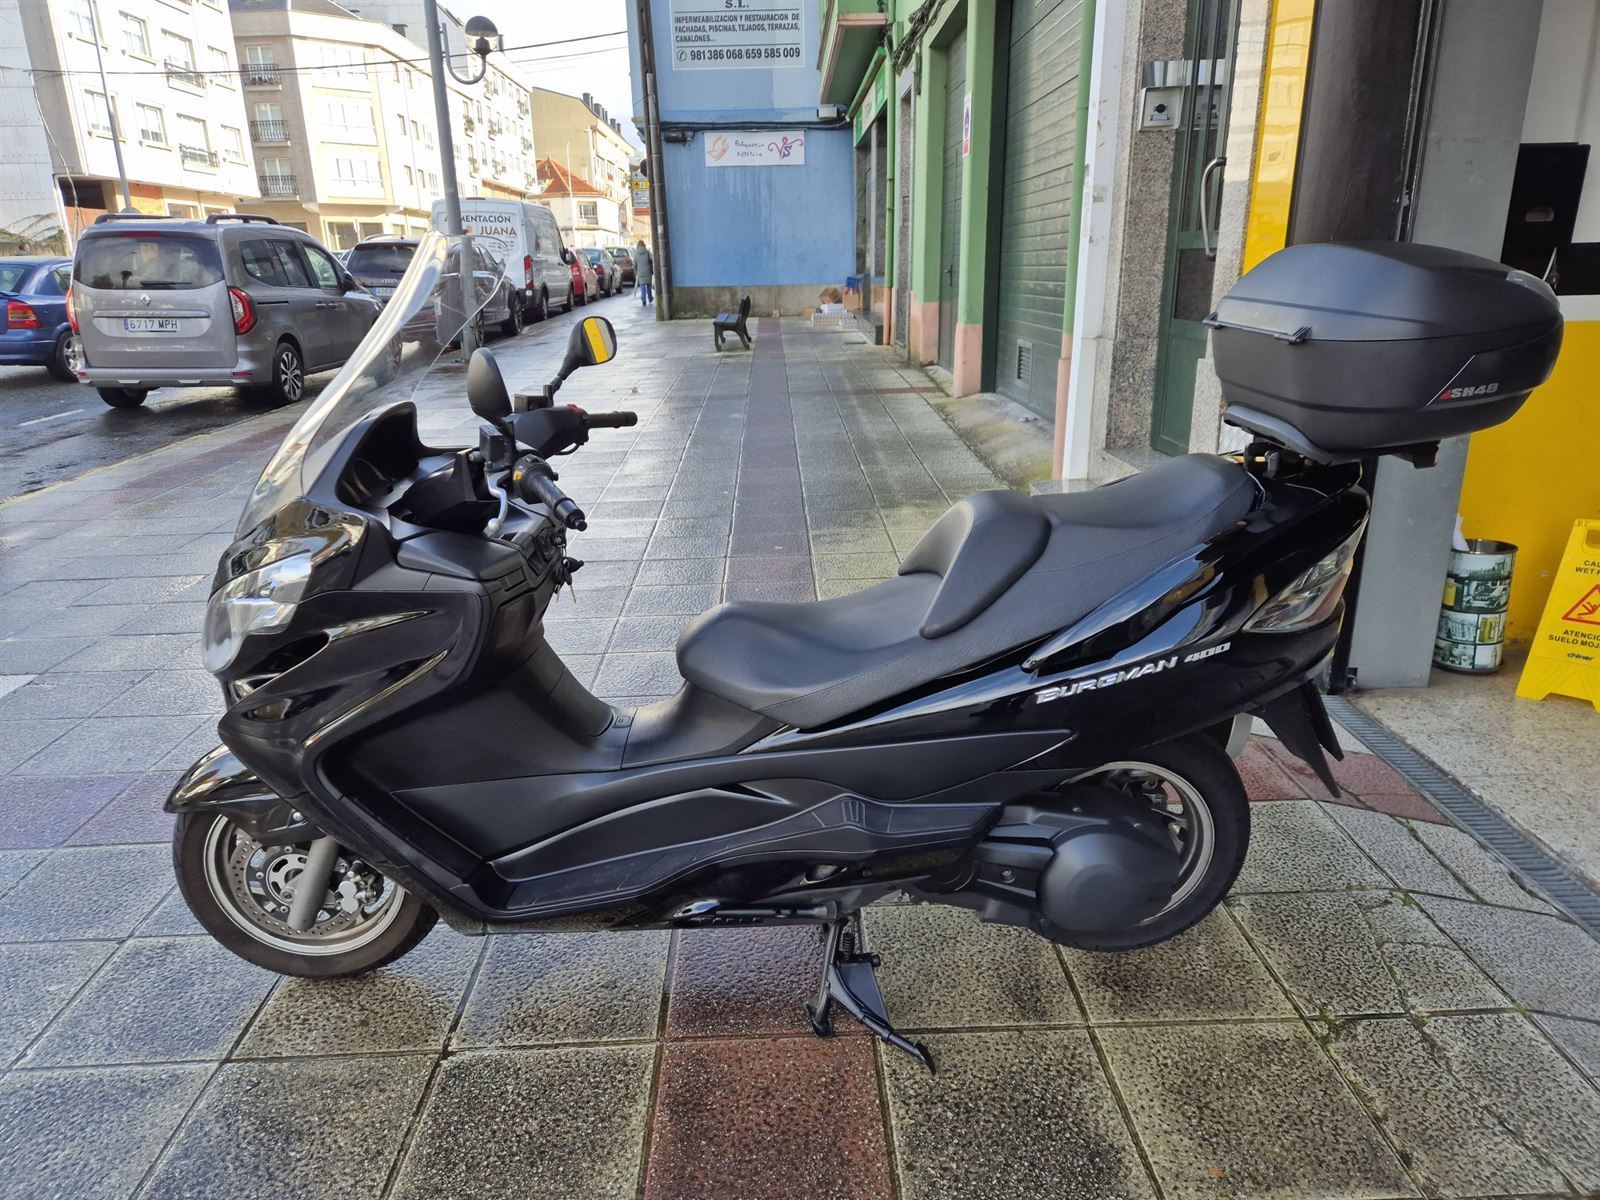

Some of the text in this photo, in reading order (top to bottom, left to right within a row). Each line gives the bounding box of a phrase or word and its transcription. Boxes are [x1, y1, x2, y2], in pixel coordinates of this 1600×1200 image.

[738, 14, 744, 23] Y
[791, 12, 800, 21] DE
[674, 22, 800, 34] FACHADAS, PISCINAS, TEJADOS, TERRAZAS,
[726, 49, 743, 60] 068
[745, 48, 762, 59] 659
[764, 47, 781, 58] 585
[783, 47, 800, 58] 009
[480, 226, 517, 236] JUANA
[129, 320, 178, 329] 6717 MPH
[1451, 382, 1499, 399] SH48
[1575, 566, 1594, 575] WET
[1548, 634, 1600, 649] SUELO MOJ
[1034, 641, 1232, 704] BURGMAN 400
